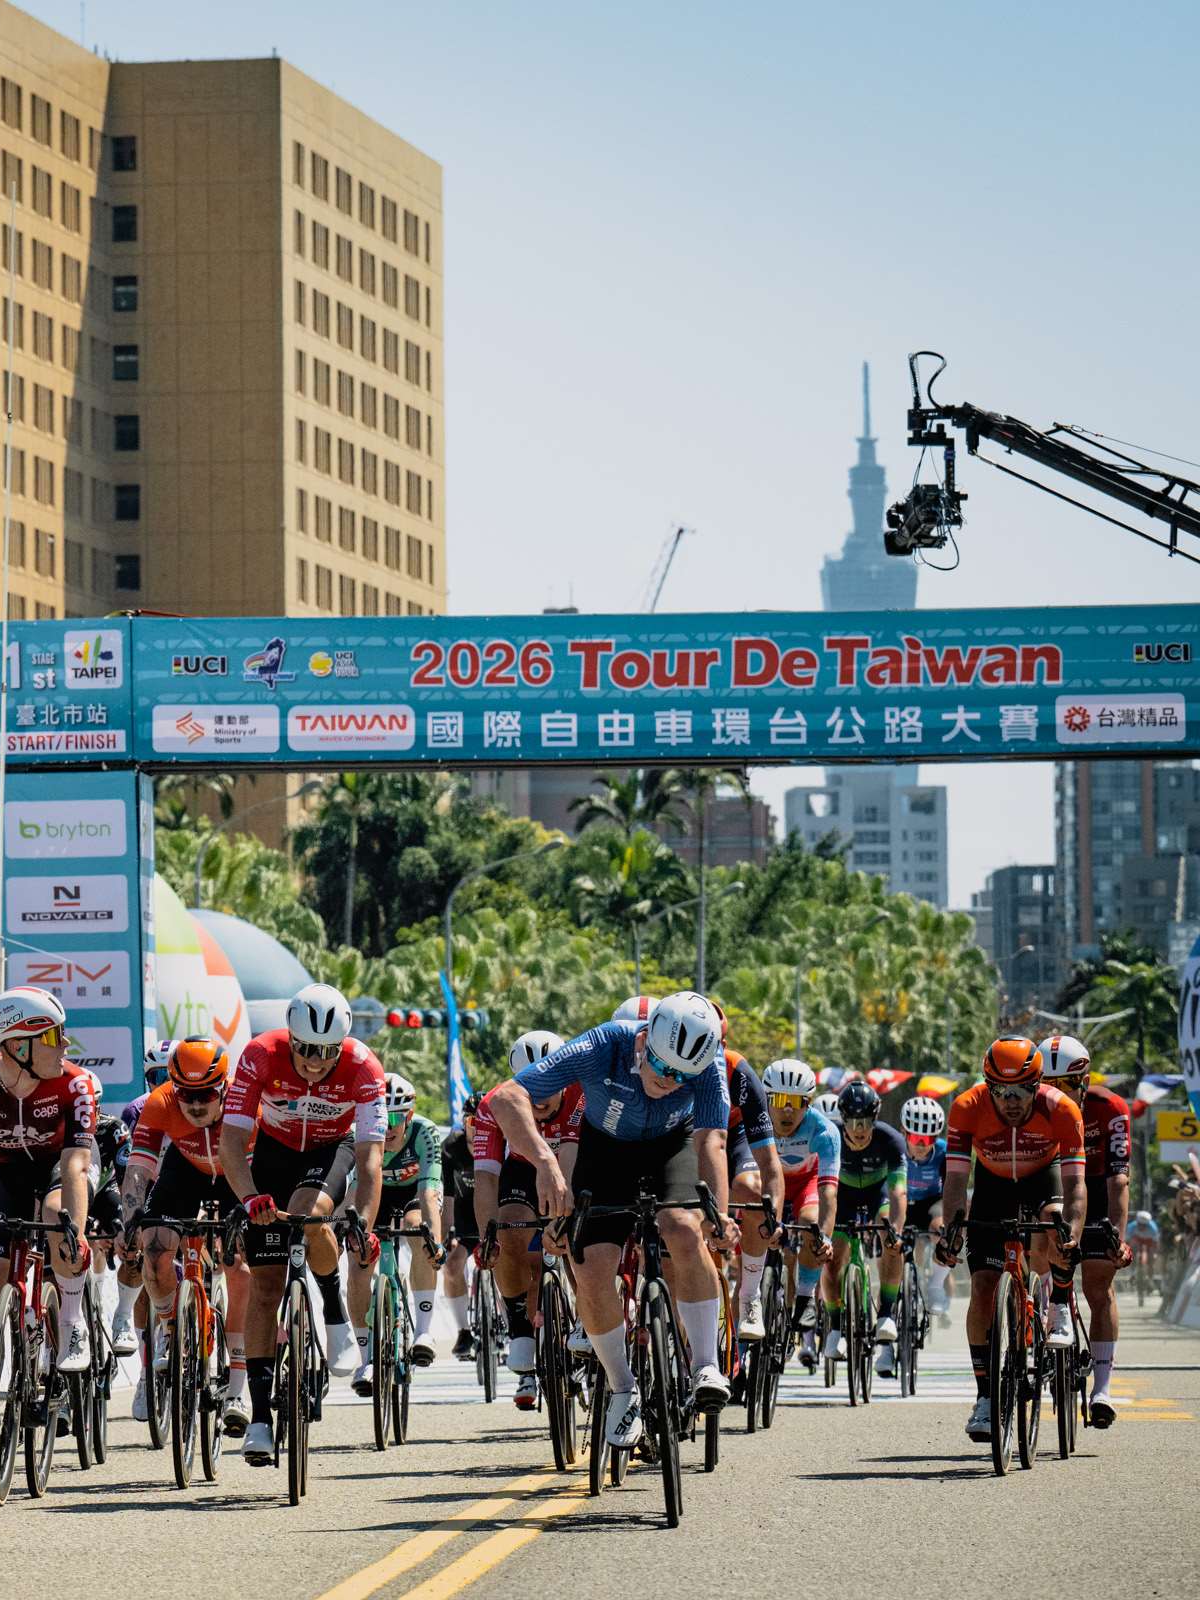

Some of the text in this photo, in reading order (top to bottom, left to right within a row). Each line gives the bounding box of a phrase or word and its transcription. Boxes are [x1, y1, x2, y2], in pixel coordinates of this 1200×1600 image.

[1145, 644, 1191, 662] UCI
[184, 656, 226, 674] UCI
[411, 635, 1063, 690] 2026 Tour De Taiwan
[33, 668, 56, 689] st
[72, 667, 116, 678] TAIPEI
[16, 703, 107, 726] 臺北市站
[296, 714, 407, 731] TAIWAN
[1096, 706, 1179, 729] 台灣精品
[214, 728, 247, 738] Ministry
[427, 704, 1039, 748] 國際自由車環台公路大賽
[7, 733, 117, 751] START/FINISH
[214, 736, 242, 746] Sports
[25, 911, 112, 921] NOVATEC
[26, 963, 112, 983] ZIV
[33, 1103, 59, 1119] caps
